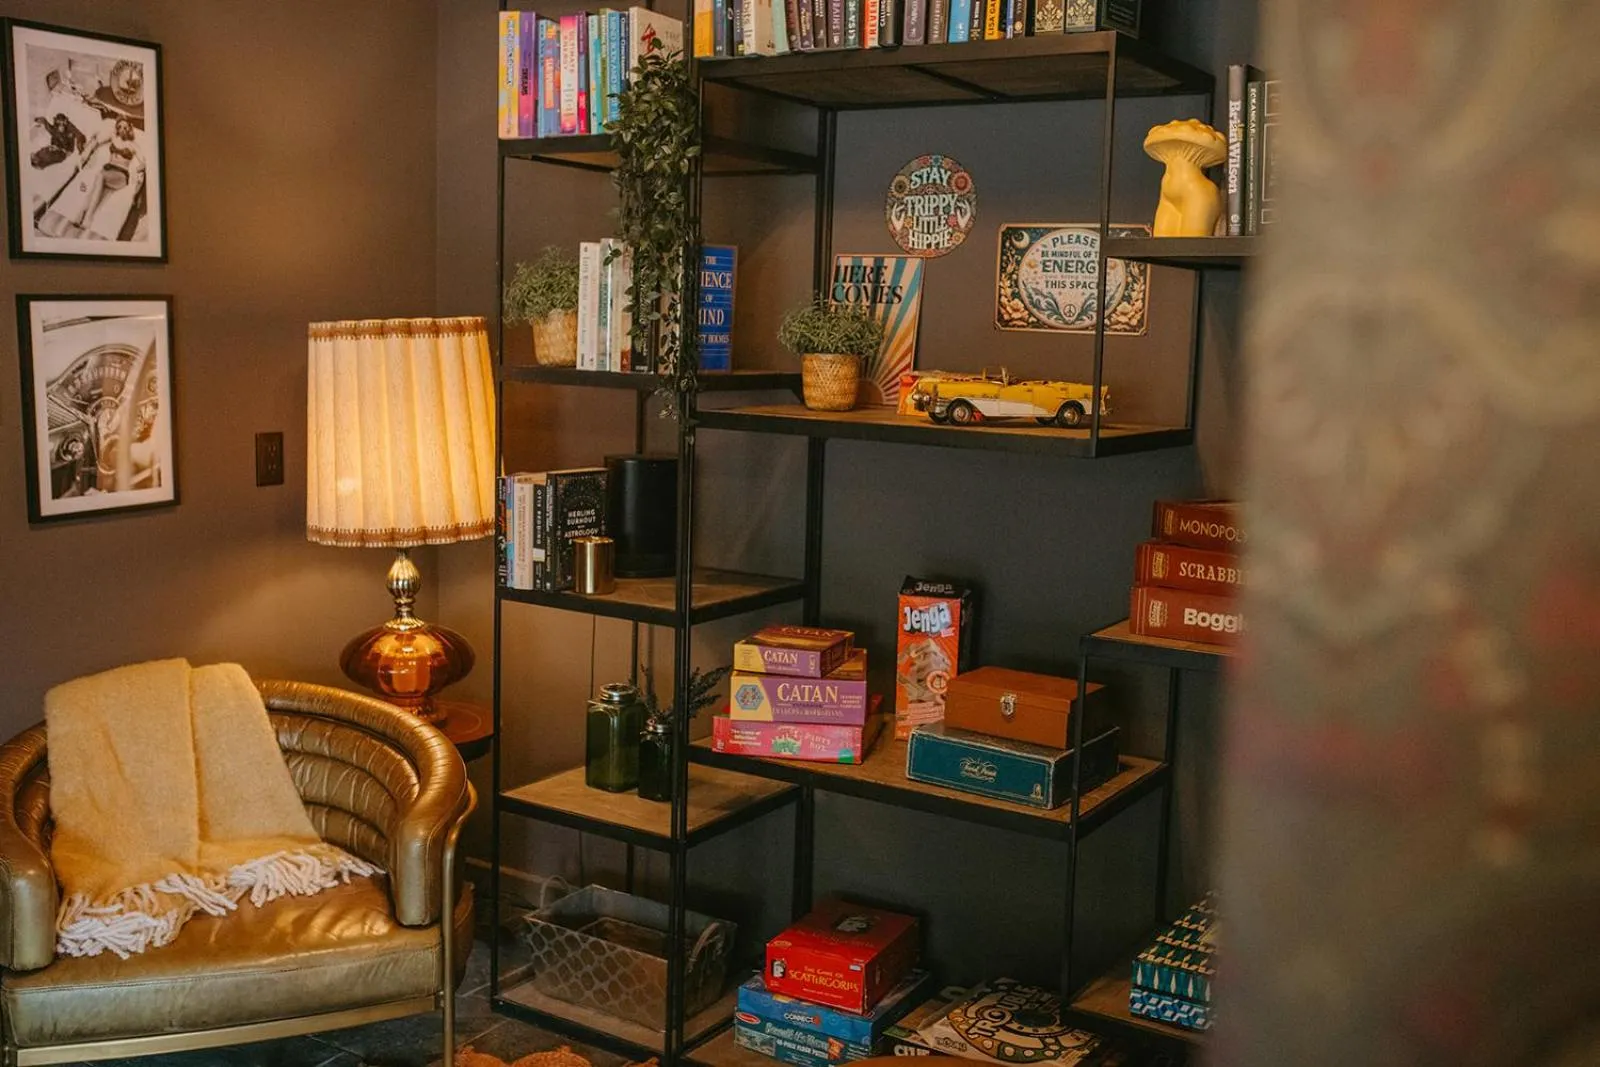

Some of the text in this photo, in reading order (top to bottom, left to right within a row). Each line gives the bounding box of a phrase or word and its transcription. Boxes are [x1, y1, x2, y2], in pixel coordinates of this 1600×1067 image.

[988, 17, 996, 36] LISA
[1228, 100, 1242, 194] Brian Wilson
[911, 166, 951, 189] STAY
[903, 193, 958, 216] TRIPPY
[913, 215, 948, 233] LITTLE
[909, 228, 953, 249] HIPPIE
[1052, 233, 1098, 249] PLEASE
[1041, 250, 1049, 258] BE
[1051, 250, 1081, 258] MINDFUL
[1083, 250, 1092, 258] OF
[834, 265, 888, 284] HERE
[1042, 259, 1098, 274] ENERG
[700, 271, 732, 288] IENCE
[1044, 280, 1067, 289] THIS
[832, 285, 903, 305] COMES
[564, 528, 599, 538] ASTROLOGY
[1179, 561, 1246, 585] SCRABBL
[915, 581, 953, 593] Jenga
[903, 601, 952, 633] Jenga
[1183, 607, 1247, 634] Boggl
[764, 650, 799, 664] CATAN
[777, 682, 839, 703] CATAN
[788, 969, 859, 993] SCATTERGORIES
